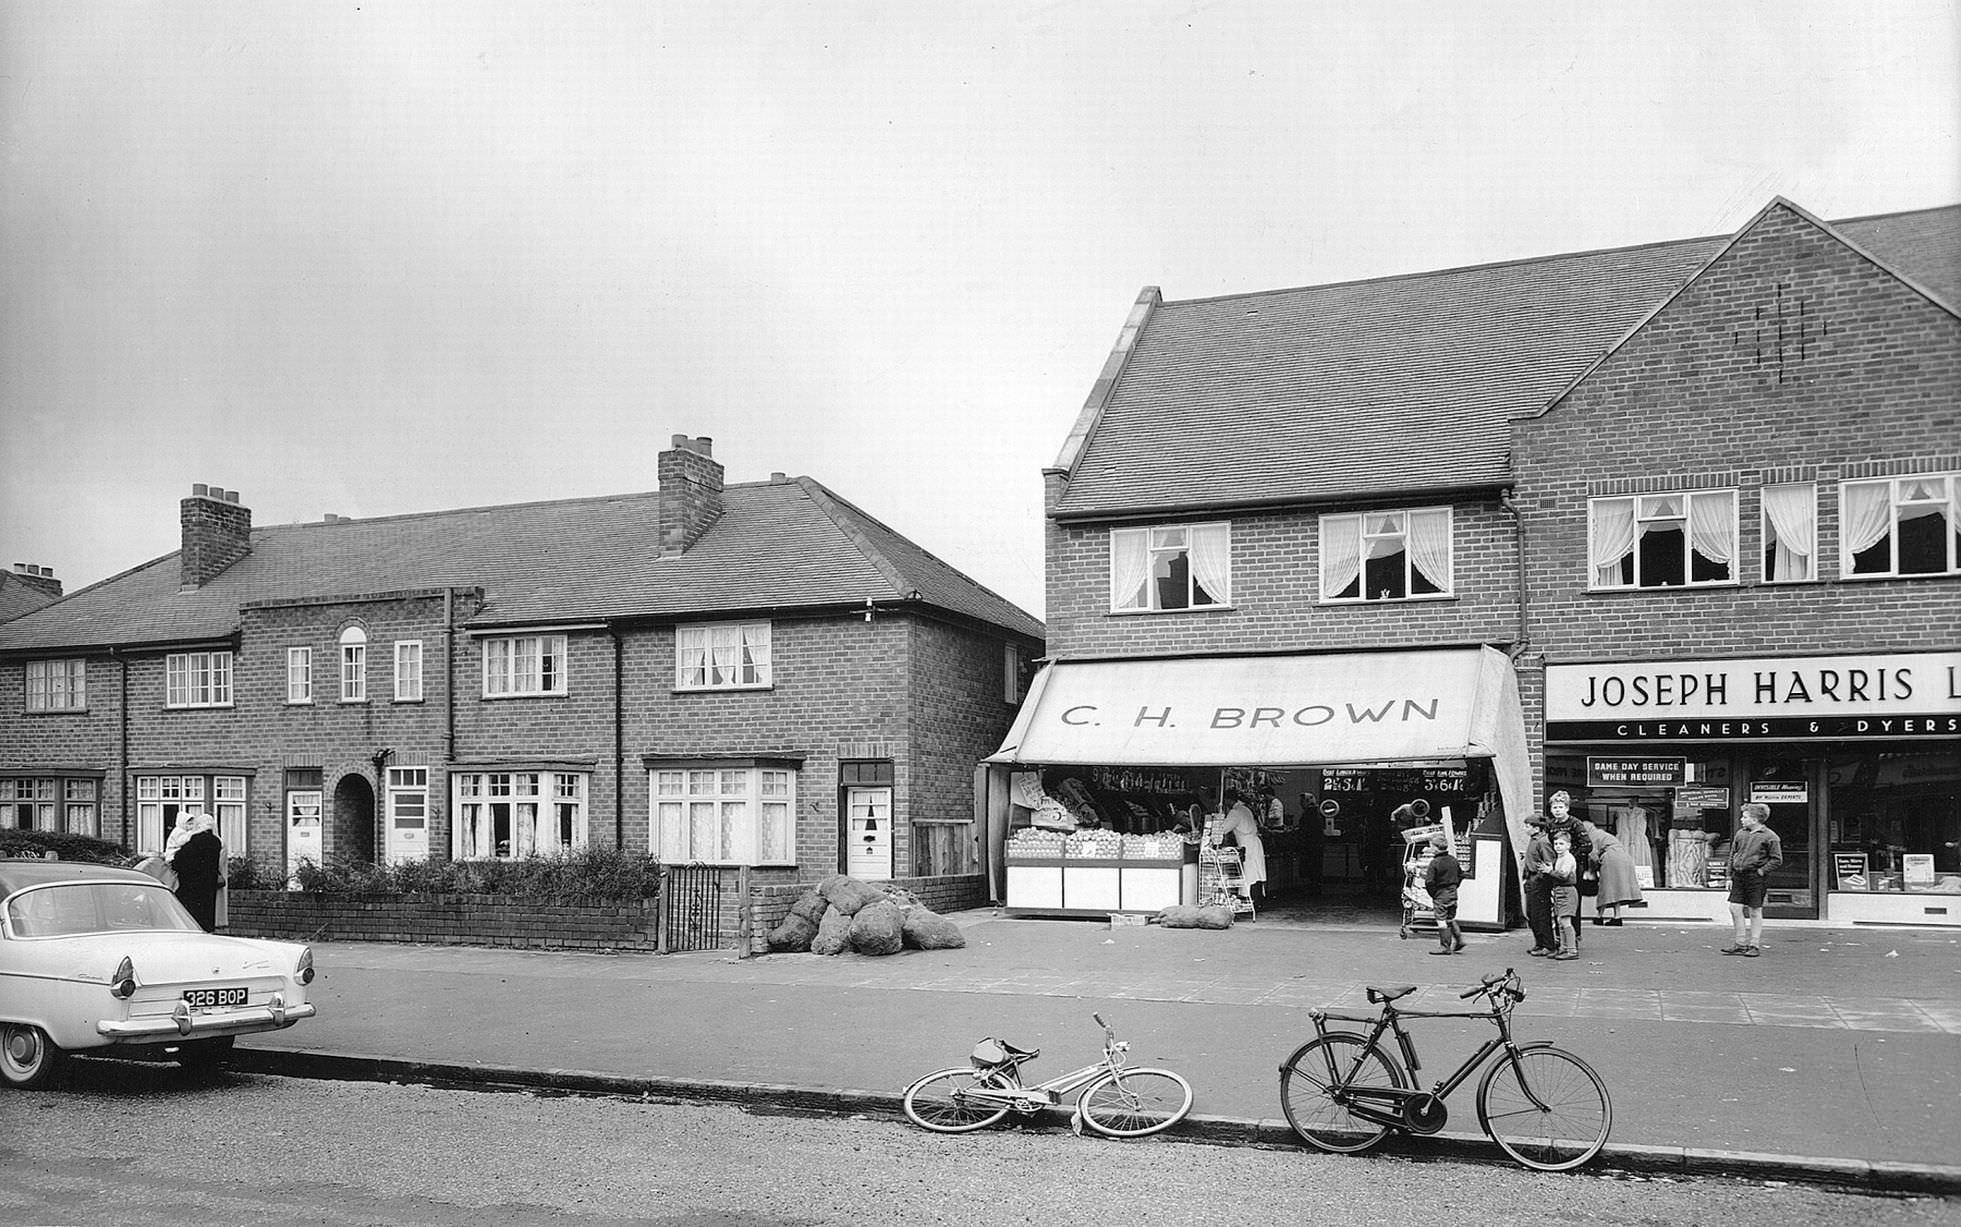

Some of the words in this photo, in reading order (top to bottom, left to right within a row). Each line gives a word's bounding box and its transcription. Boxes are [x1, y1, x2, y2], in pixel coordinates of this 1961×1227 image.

[1581, 673, 1728, 708] JOSEPH
[1753, 668, 1913, 704] HARRIS
[1061, 705, 1101, 726] C.
[1134, 706, 1176, 728] H.
[1210, 698, 1439, 729] BROWN
[1617, 722, 1769, 737] CLEANERS
[1808, 721, 1819, 733] &
[1857, 719, 1957, 732] DYERS
[1594, 762, 1618, 771] SAME
[1621, 762, 1639, 771] DAY
[1642, 762, 1679, 771] SERVICE
[1601, 773, 1627, 782] WHEN
[1630, 773, 1673, 782] REQUIRED
[186, 991, 215, 1007] 326
[218, 990, 246, 1006] BOP
